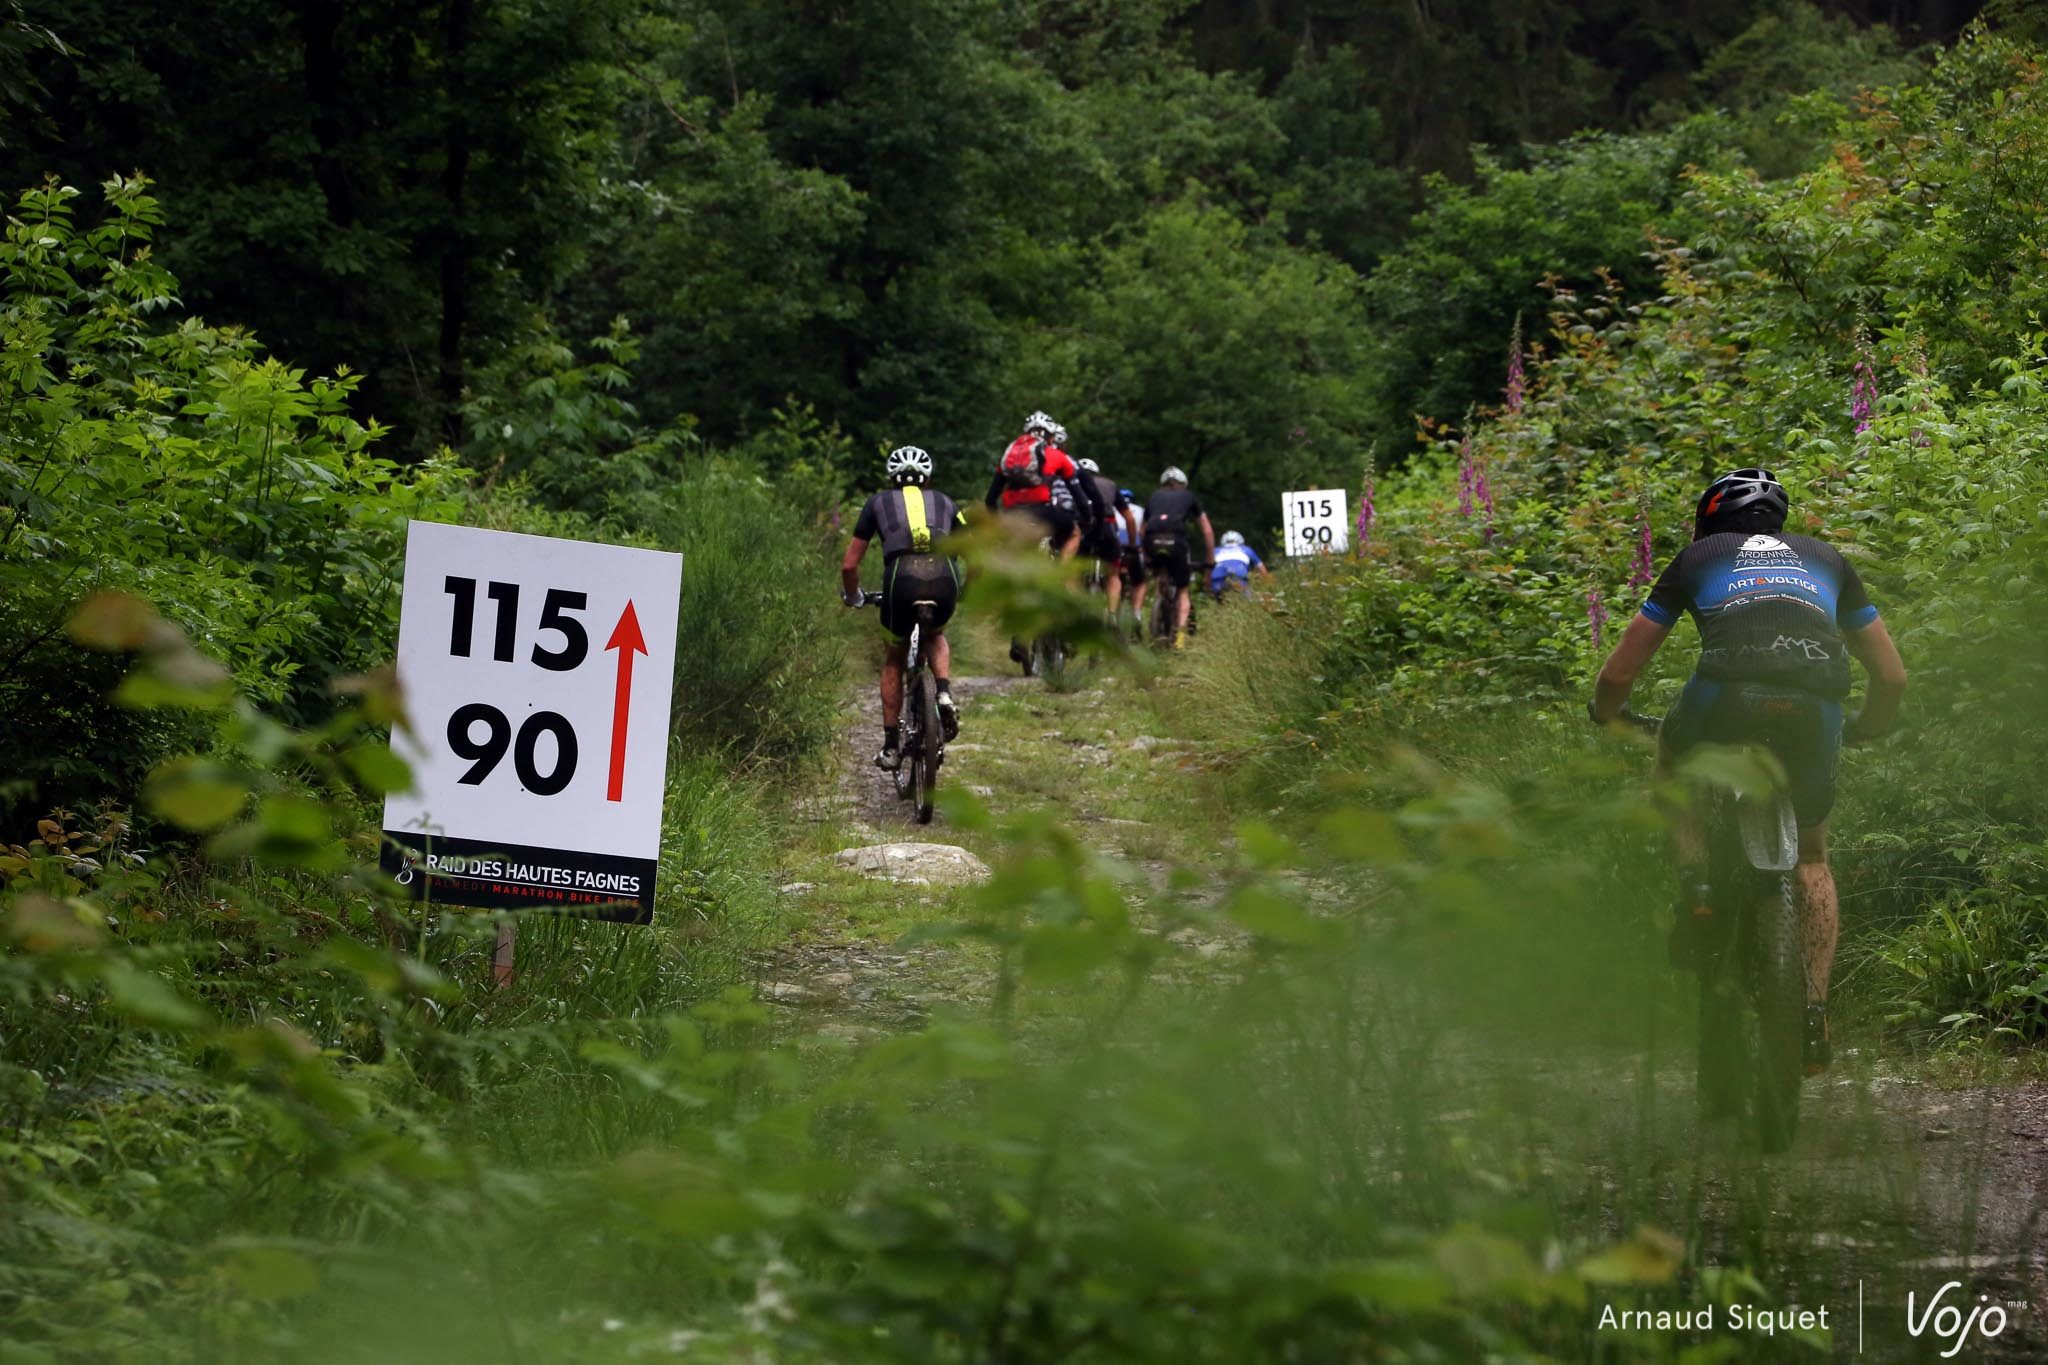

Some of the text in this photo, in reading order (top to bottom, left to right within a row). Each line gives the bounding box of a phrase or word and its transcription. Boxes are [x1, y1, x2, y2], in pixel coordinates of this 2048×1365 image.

[1297, 499, 1332, 518] 115
[1302, 525, 1332, 544] 90
[1734, 559, 1803, 567] TROPHY
[1736, 549, 1799, 559] ARDENNES
[1728, 576, 1818, 594] ART&VOLTIGE
[444, 575, 589, 672] 115
[447, 703, 578, 796] 90
[426, 854, 640, 893] RAID DES HAUTES FAGNES
[425, 877, 486, 893] ALMEDY
[492, 884, 563, 900] MARATHON
[570, 892, 601, 905] BIKE
